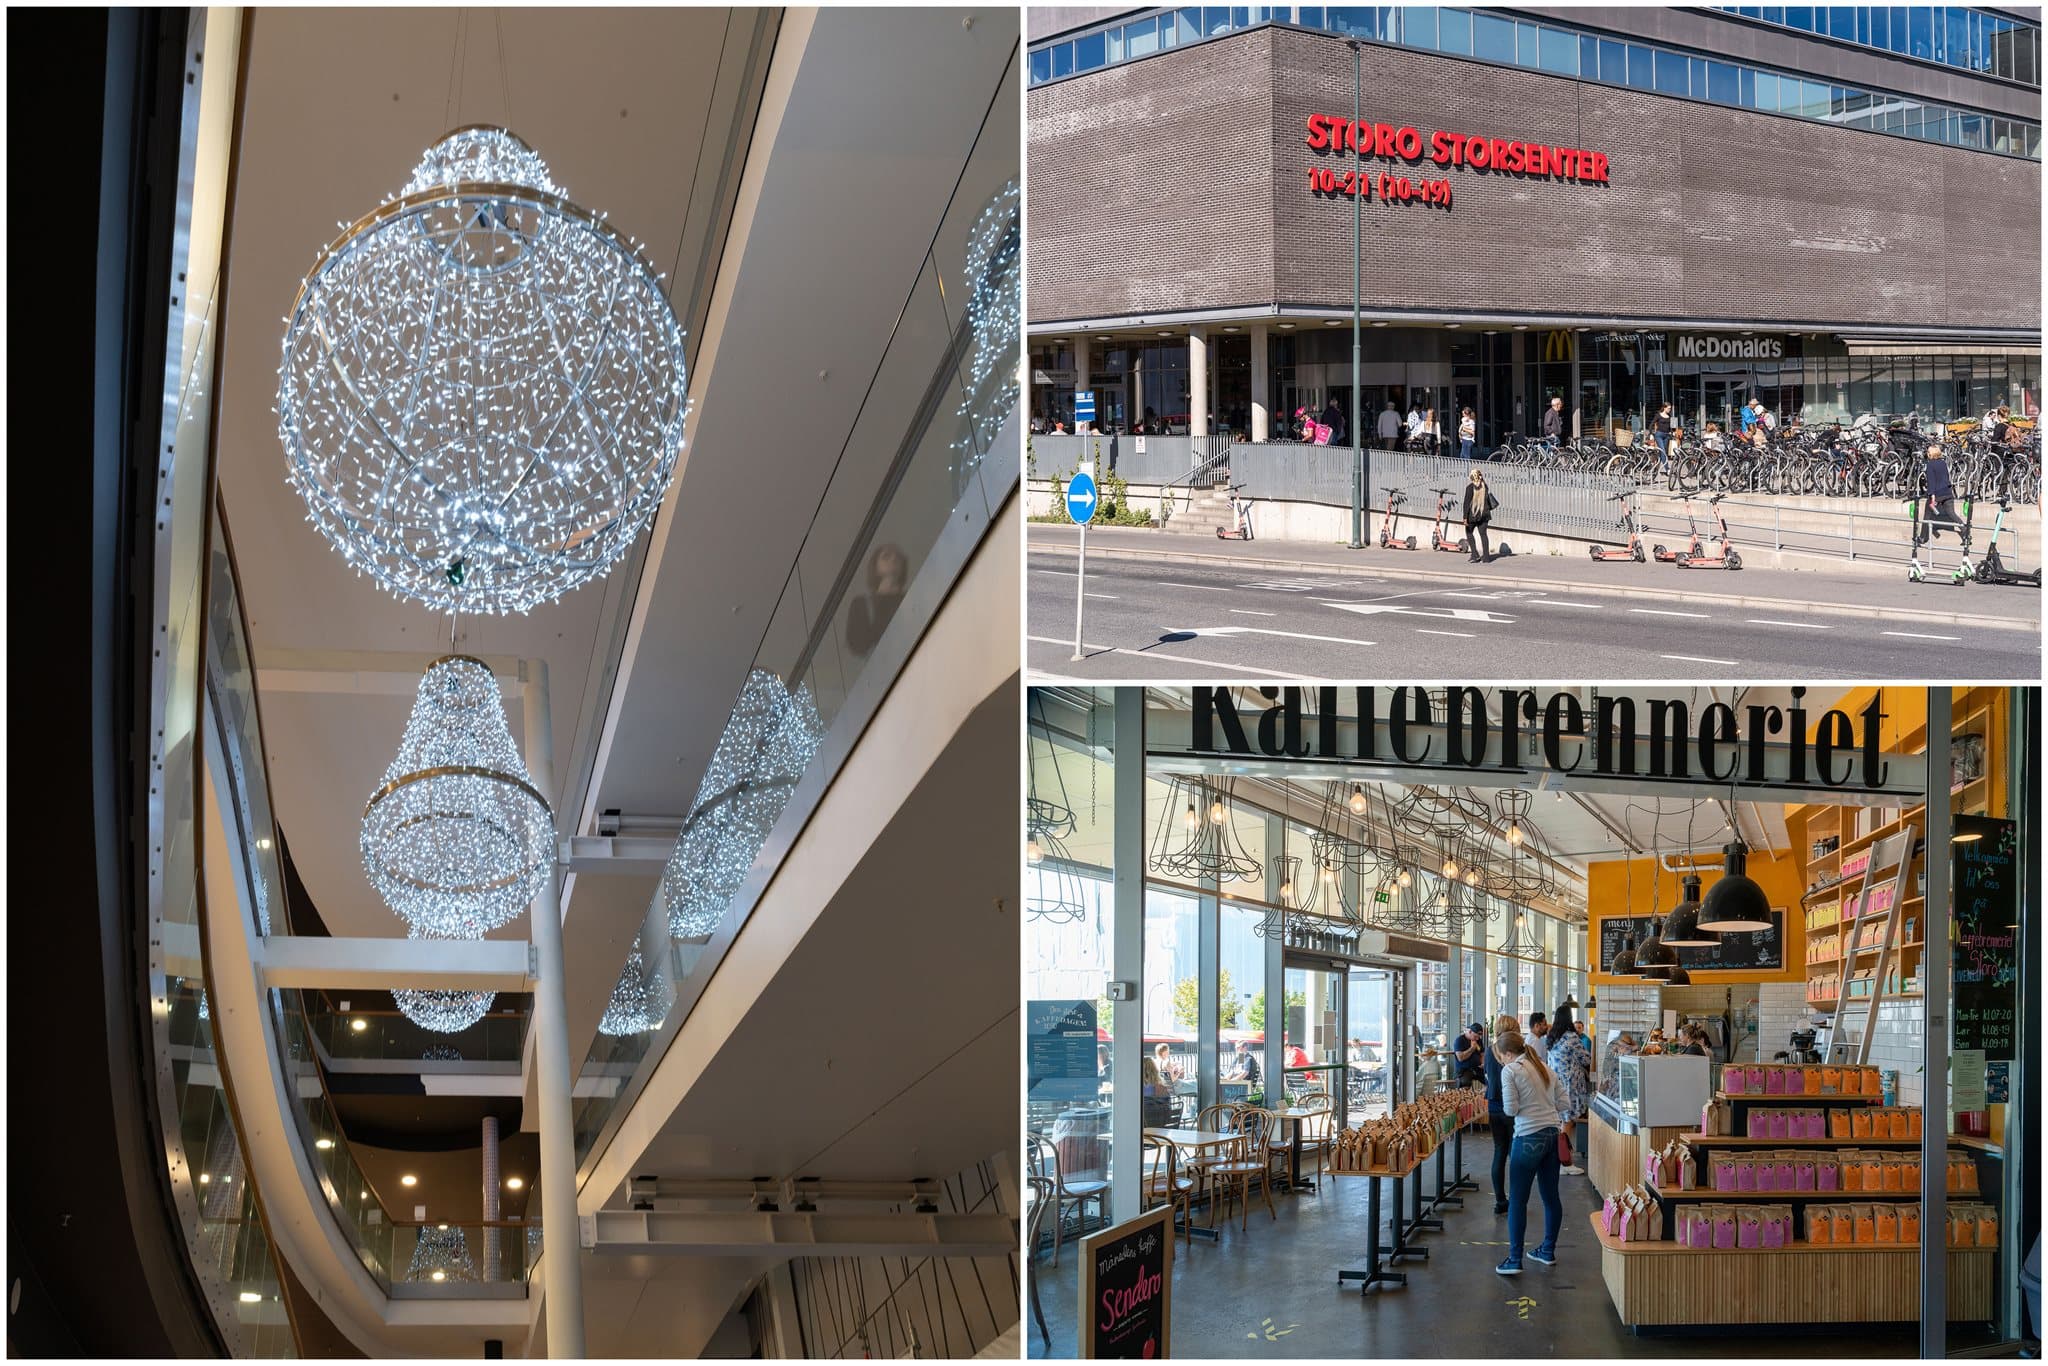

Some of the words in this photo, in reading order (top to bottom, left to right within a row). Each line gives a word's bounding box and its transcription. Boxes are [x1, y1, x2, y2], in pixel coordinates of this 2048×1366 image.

[1307, 113, 1423, 160] STORO
[1431, 131, 1609, 182] STORSENTER
[1307, 167, 1370, 196] 10-21
[1378, 171, 1452, 207] (10-19)
[1678, 336, 1782, 358] McDonald's
[1969, 949, 1998, 976] Storo
[1101, 1264, 1161, 1332] Sendero
